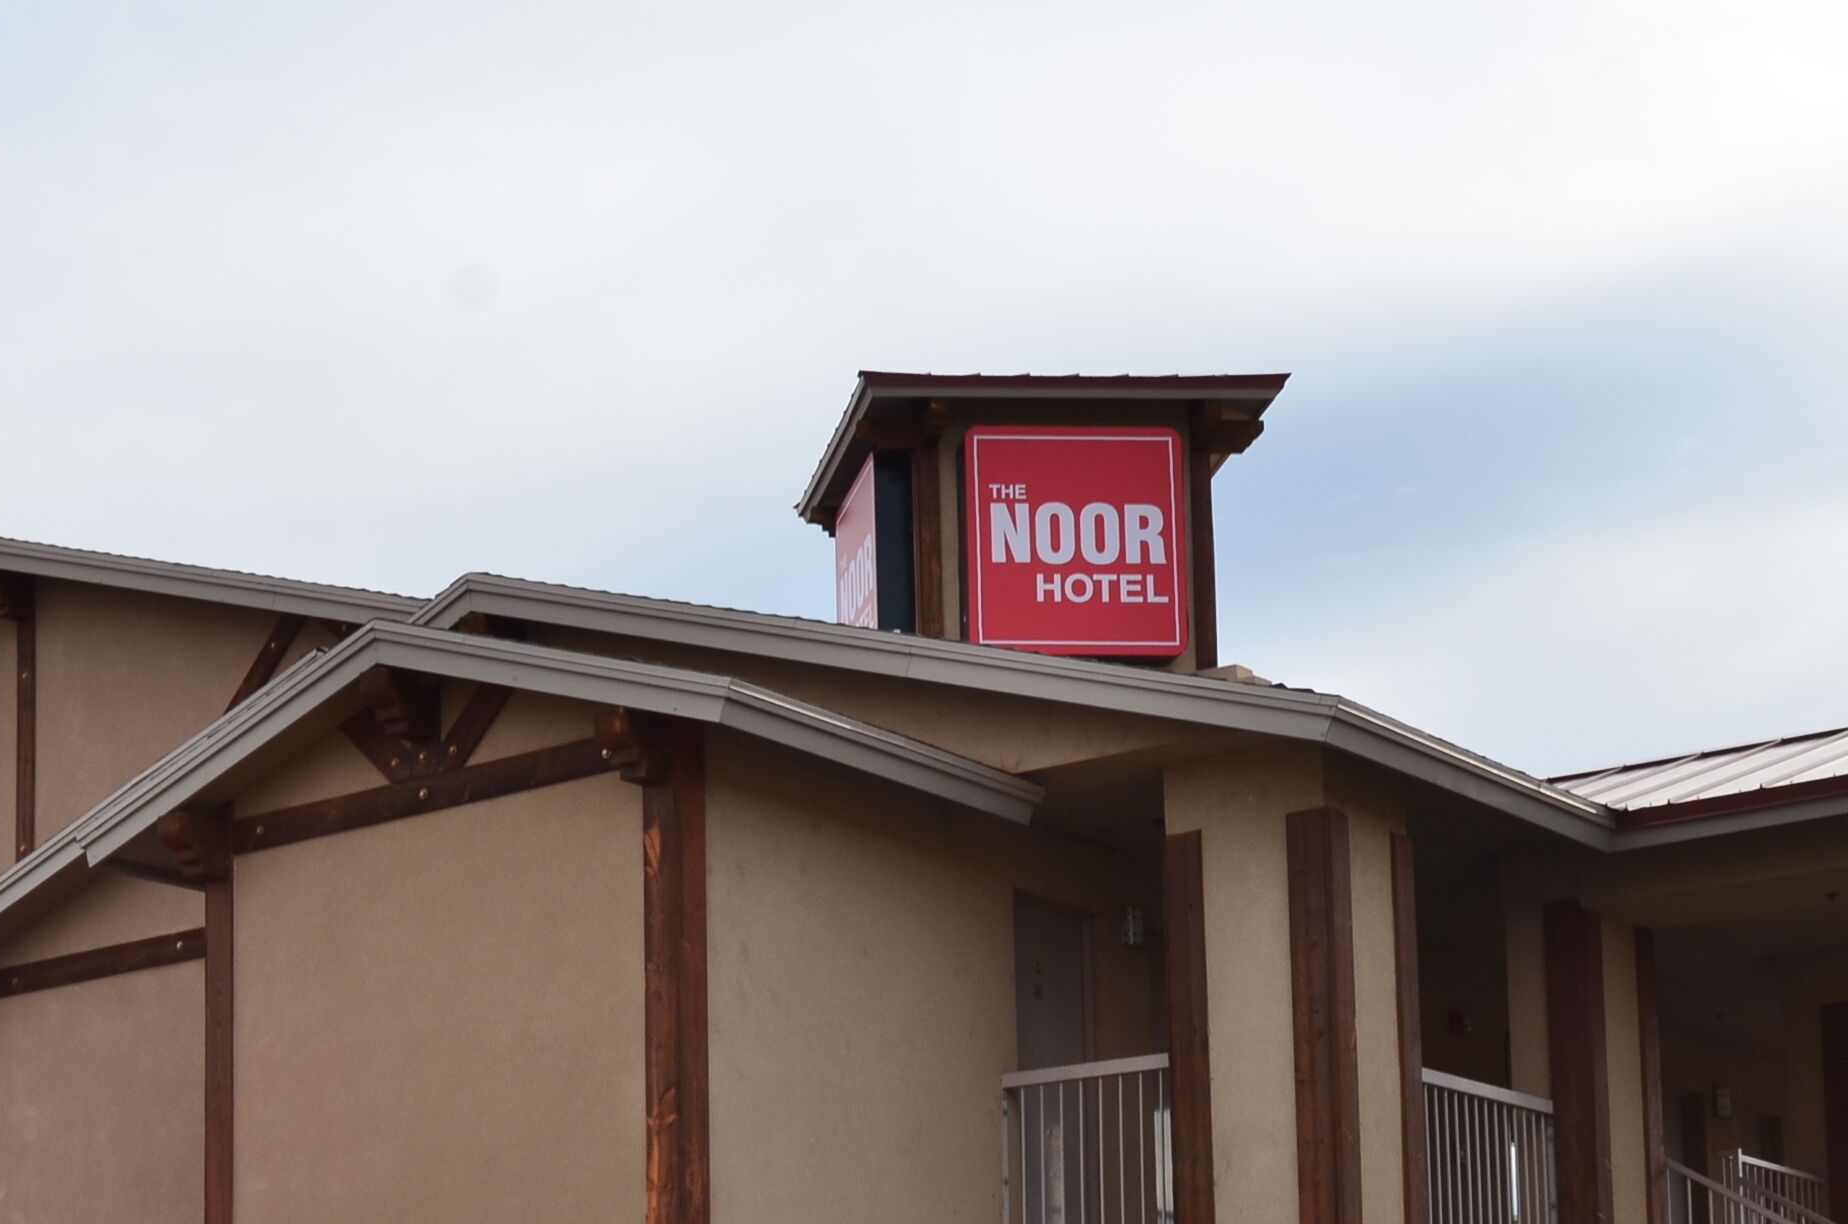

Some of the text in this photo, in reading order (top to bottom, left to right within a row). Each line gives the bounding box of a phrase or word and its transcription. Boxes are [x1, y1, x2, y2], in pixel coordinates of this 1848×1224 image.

[989, 484, 1026, 499] THE
[990, 502, 1167, 565] NOOR
[840, 532, 873, 625] NOOR
[1036, 573, 1169, 603] HOTEL
